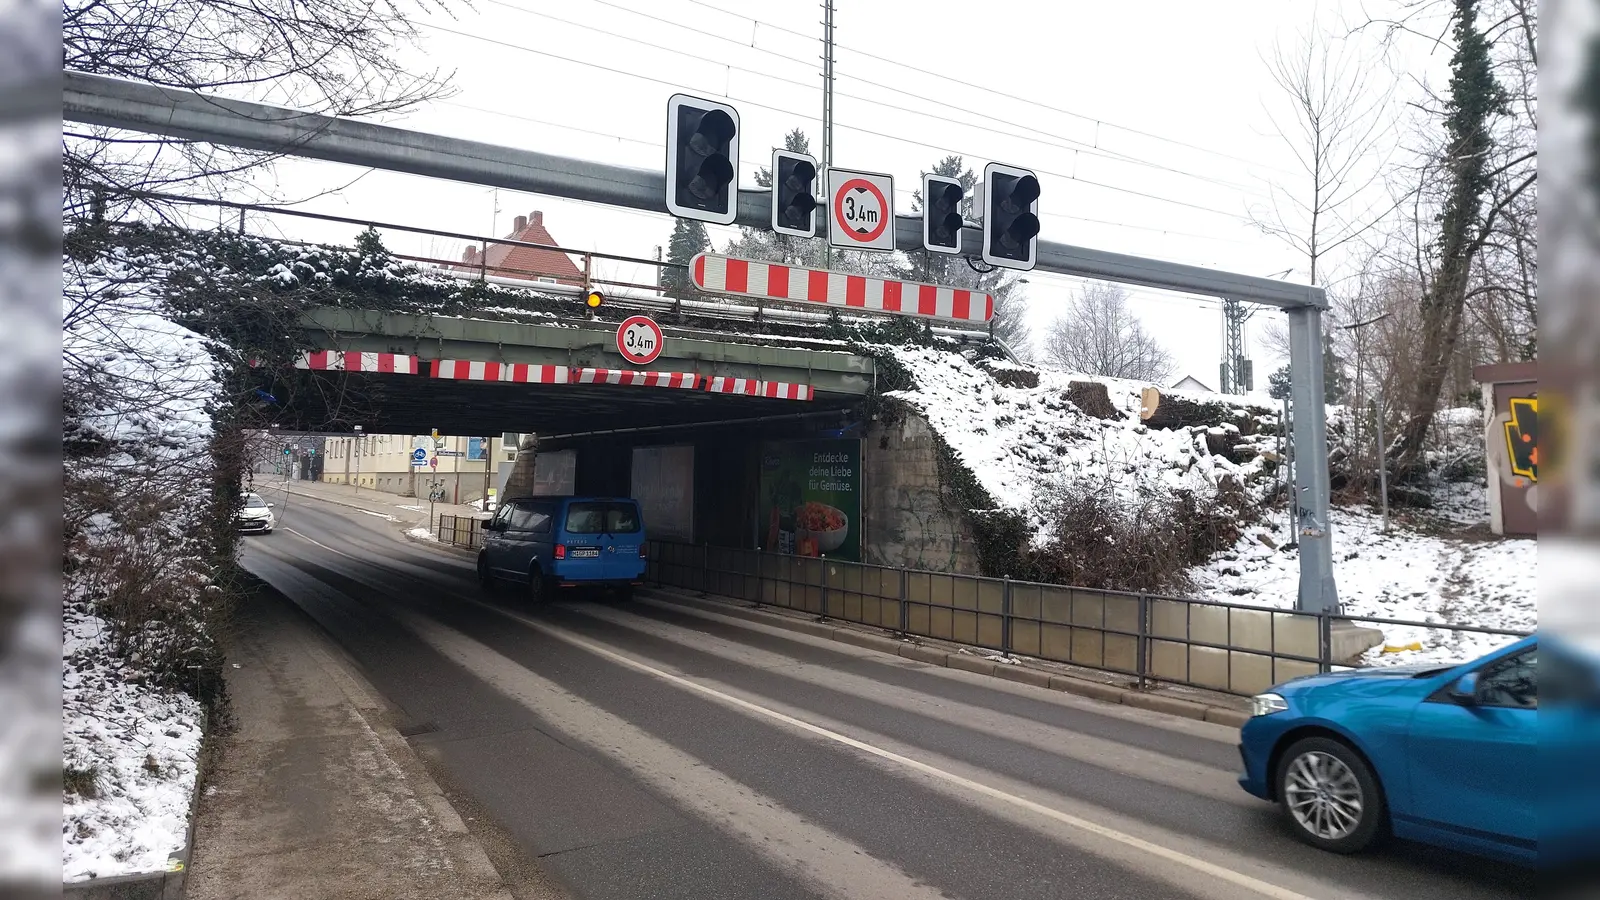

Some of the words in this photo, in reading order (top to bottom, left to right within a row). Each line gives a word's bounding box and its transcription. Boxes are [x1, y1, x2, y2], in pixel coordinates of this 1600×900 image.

[813, 452, 849, 463] Entdecke
[809, 466, 829, 477] deine
[830, 466, 852, 477] Liebe
[808, 480, 819, 490] für
[820, 480, 852, 491] Gemüse.
